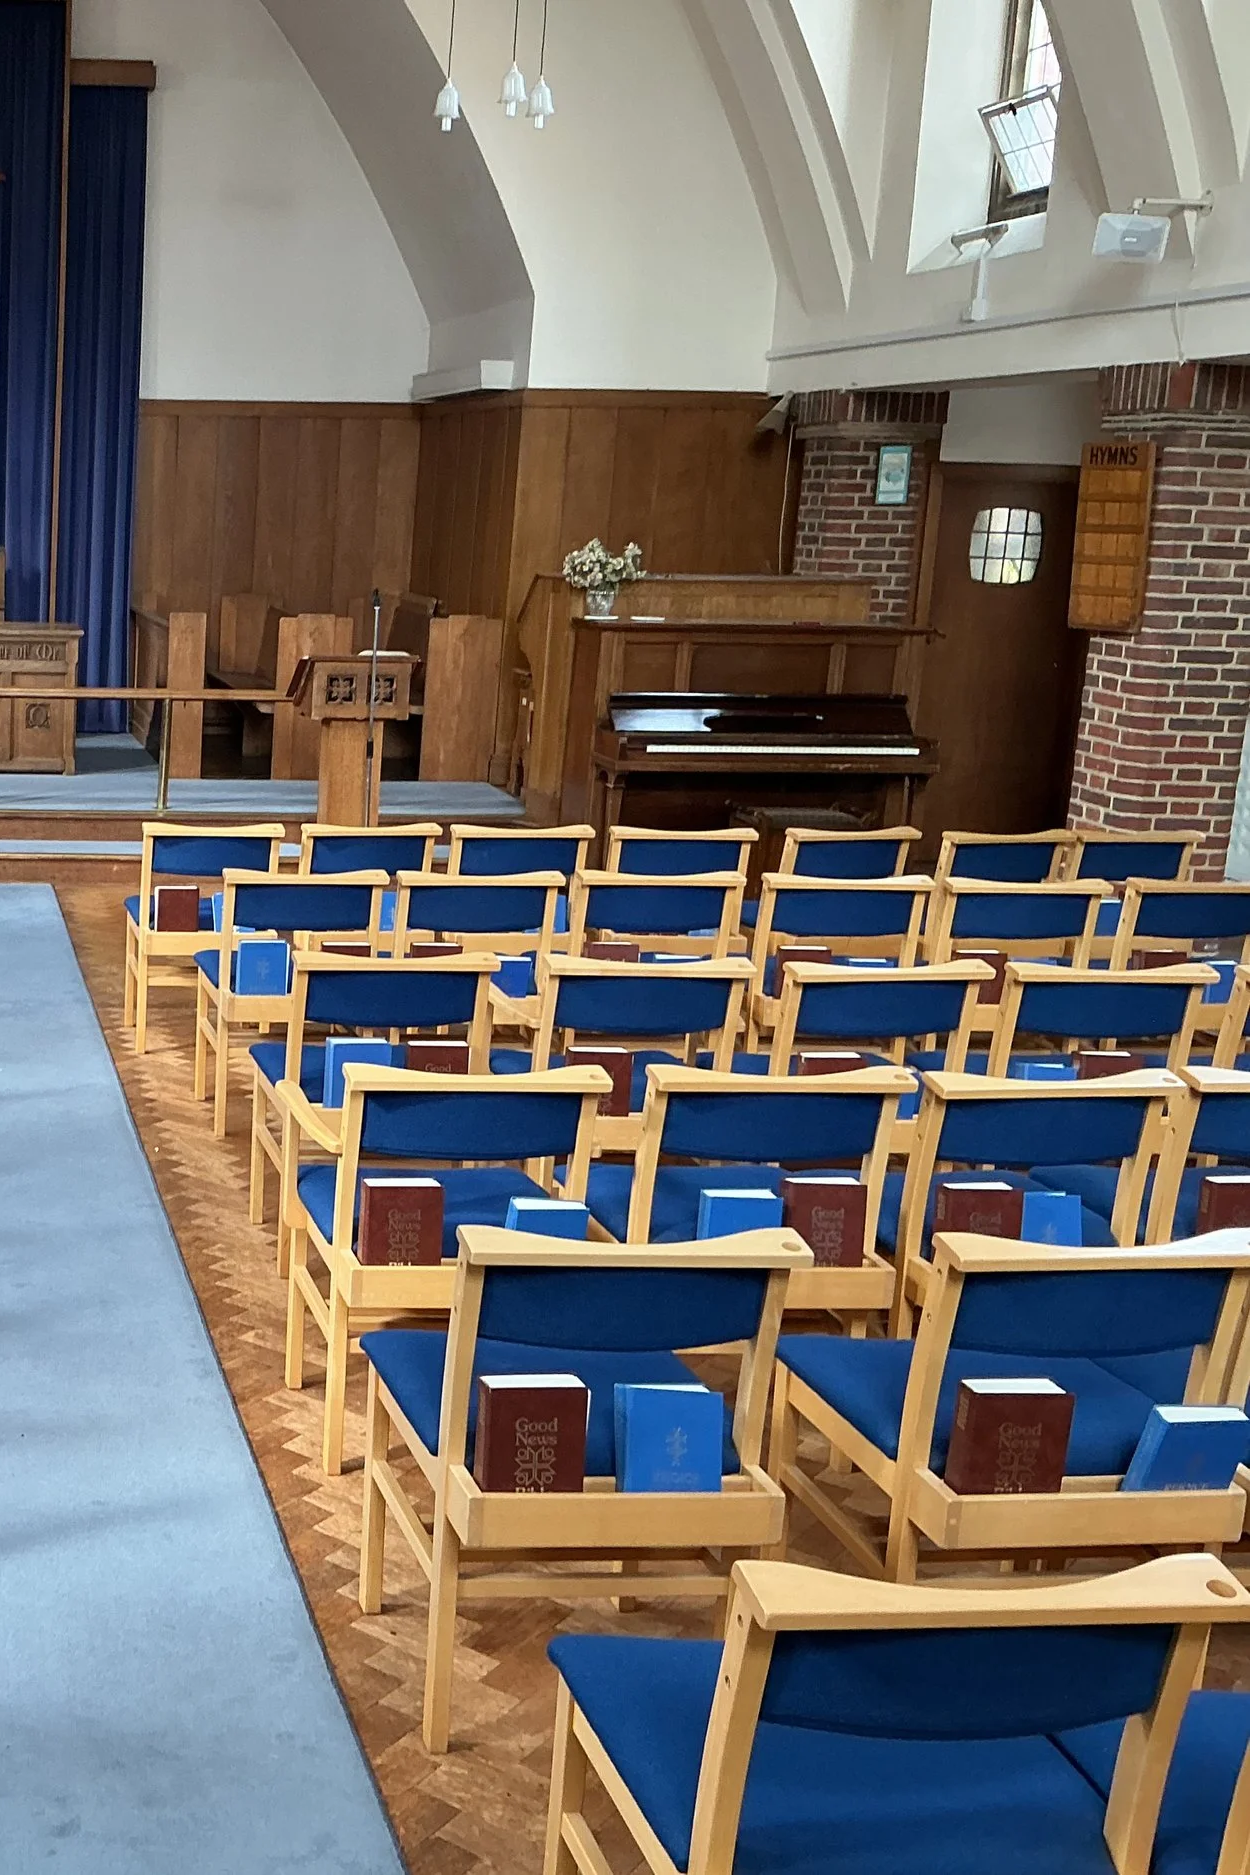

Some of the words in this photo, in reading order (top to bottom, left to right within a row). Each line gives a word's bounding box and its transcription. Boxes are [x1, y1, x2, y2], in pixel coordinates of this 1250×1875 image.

[1090, 446, 1138, 465] HYMNS
[388, 1208, 422, 1220] Good
[515, 1417, 558, 1432] Good
[999, 1422, 1043, 1437] Good
[515, 1432, 558, 1446] News
